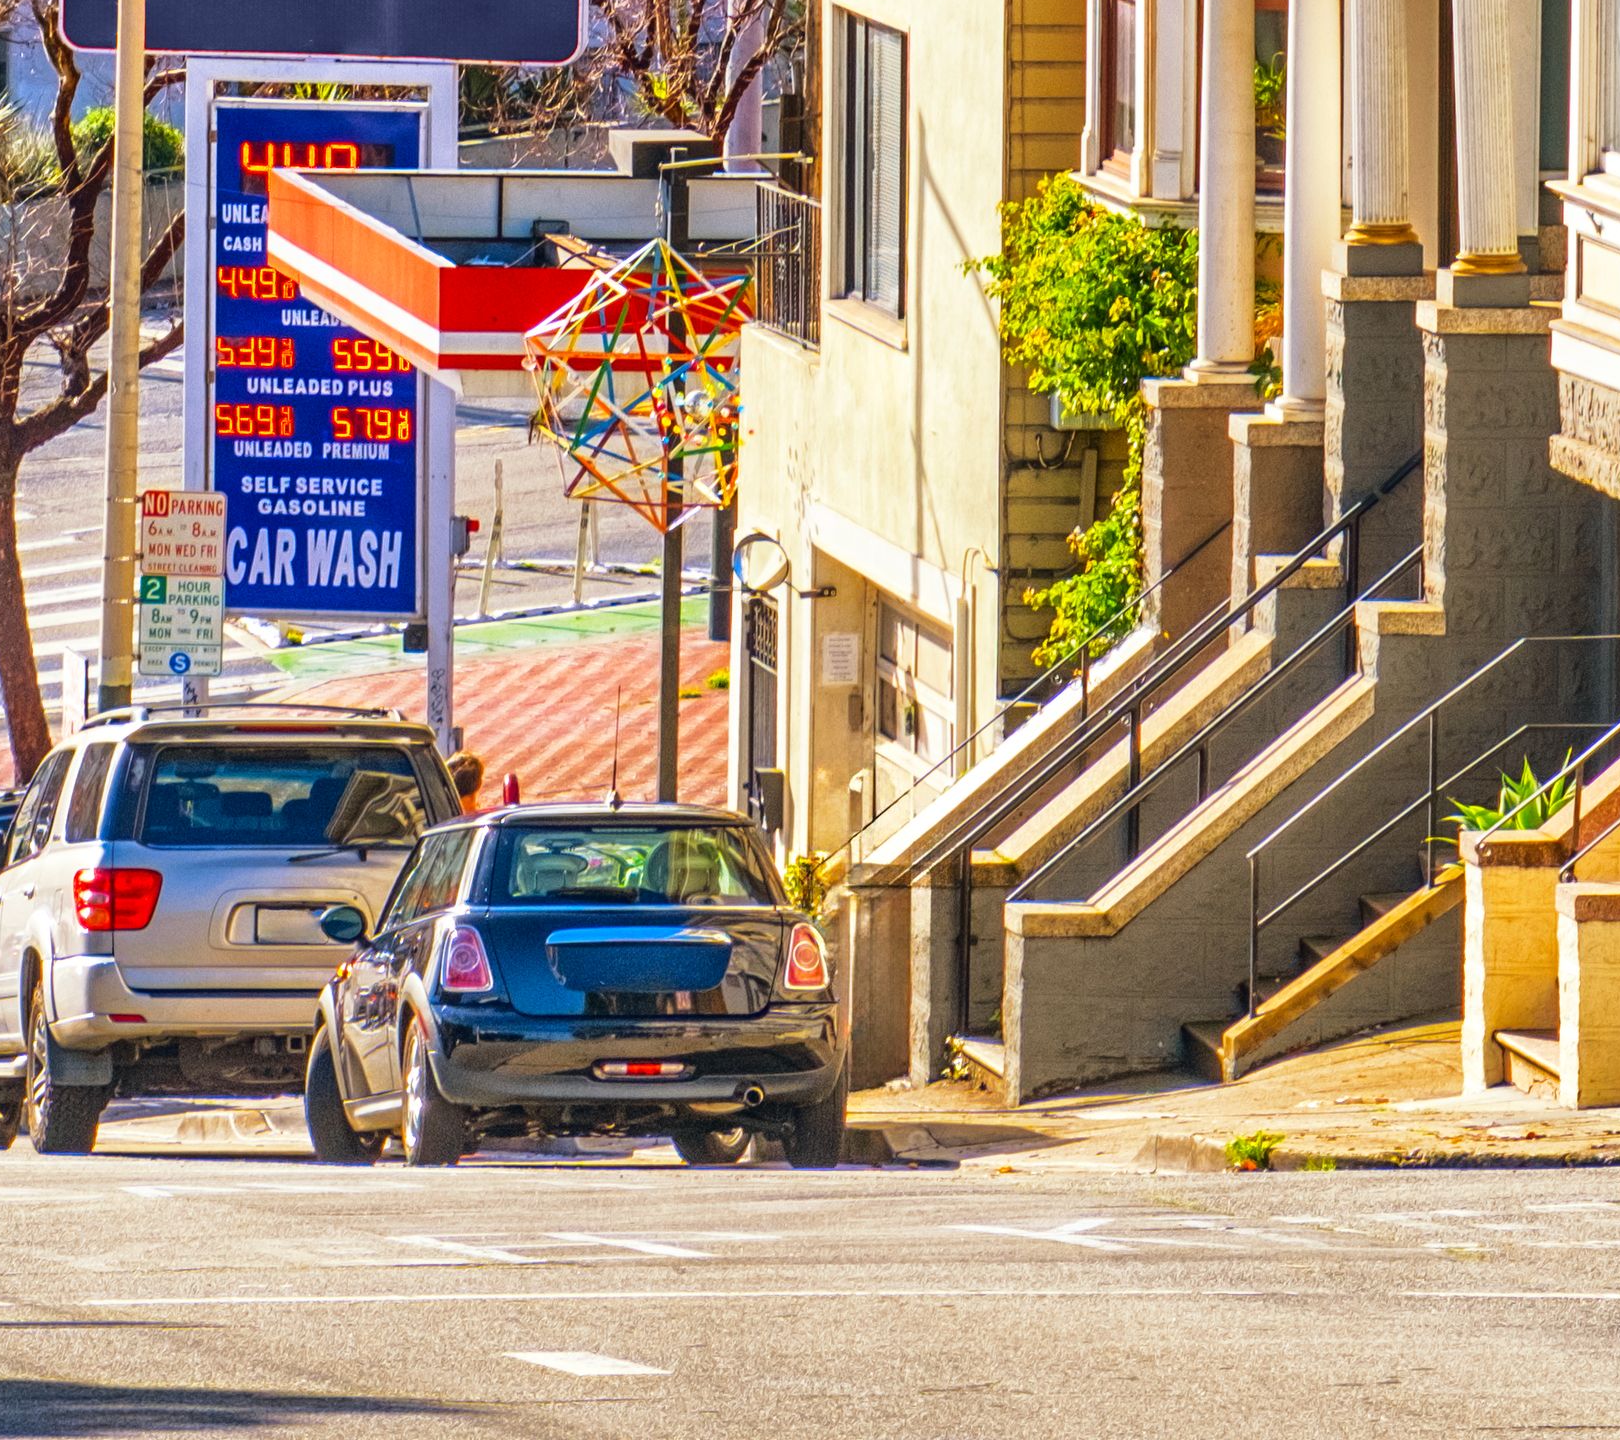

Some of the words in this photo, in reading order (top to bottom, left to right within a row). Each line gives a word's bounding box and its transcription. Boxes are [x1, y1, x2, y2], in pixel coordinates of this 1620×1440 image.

[223, 236, 262, 252] CASH
[247, 378, 343, 395] UNLEADED
[348, 379, 393, 397] PLUS
[216, 404, 275, 435] 569
[333, 408, 392, 439] 579
[234, 440, 312, 459] UNLEADED
[323, 442, 390, 460] PREMIUM
[241, 476, 290, 494] SELF
[296, 477, 383, 496] SERVICE
[145, 493, 168, 515] NO
[171, 500, 223, 516] PARKING
[258, 500, 366, 517] GASOLINE
[148, 543, 171, 556] MON
[175, 544, 196, 557] WED
[201, 545, 217, 557] FRI
[227, 525, 296, 586] CAR
[307, 528, 403, 589] WASH
[148, 562, 176, 571] STREET
[146, 578, 161, 600] 2
[178, 582, 211, 593] HOUR
[169, 594, 220, 606] PARKING
[149, 628, 171, 638] MON
[197, 629, 213, 639] FRI
[174, 656, 186, 671] S
